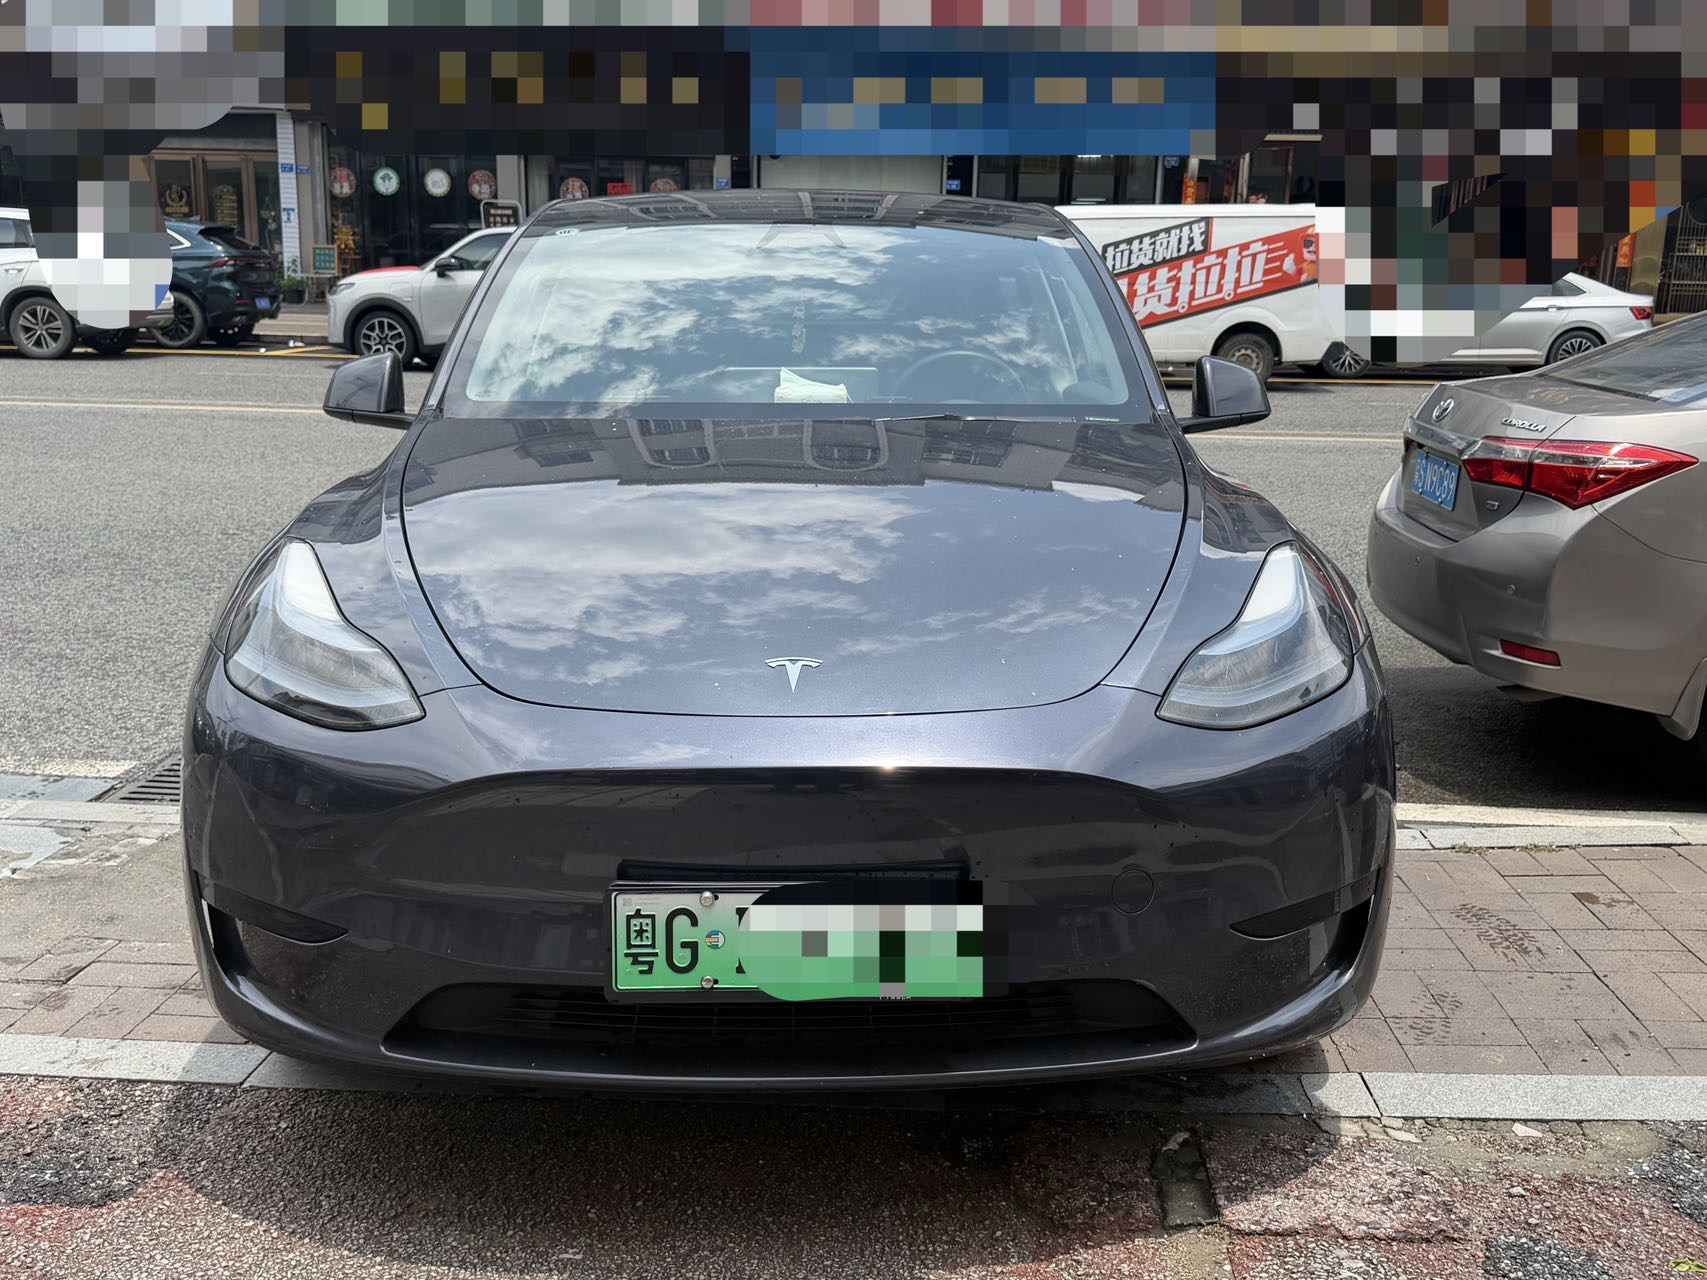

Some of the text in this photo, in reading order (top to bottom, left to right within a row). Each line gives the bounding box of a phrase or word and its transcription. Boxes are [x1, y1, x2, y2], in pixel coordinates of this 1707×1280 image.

[1105, 221, 1206, 274] 拉货就找
[624, 908, 749, 975] 粤G
